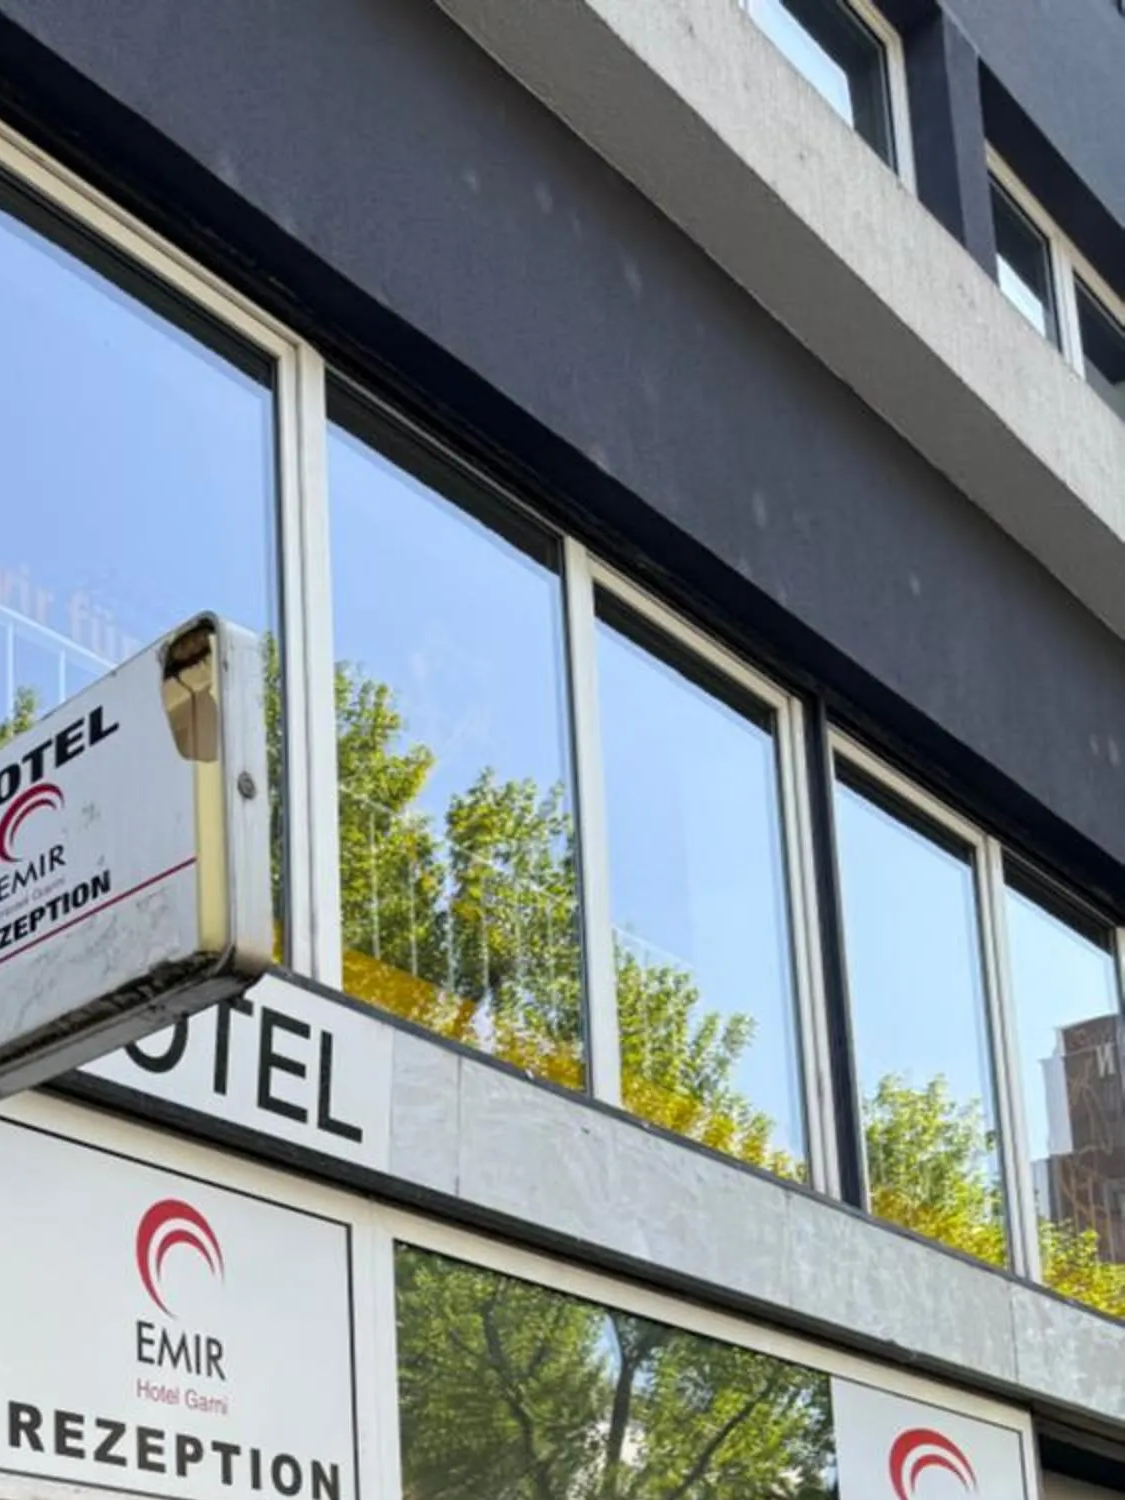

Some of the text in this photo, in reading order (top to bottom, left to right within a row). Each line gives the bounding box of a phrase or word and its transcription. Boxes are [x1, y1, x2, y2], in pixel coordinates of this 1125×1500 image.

[136, 1319, 227, 1382] EMIR
[136, 1377, 228, 1415] Hotel Garni
